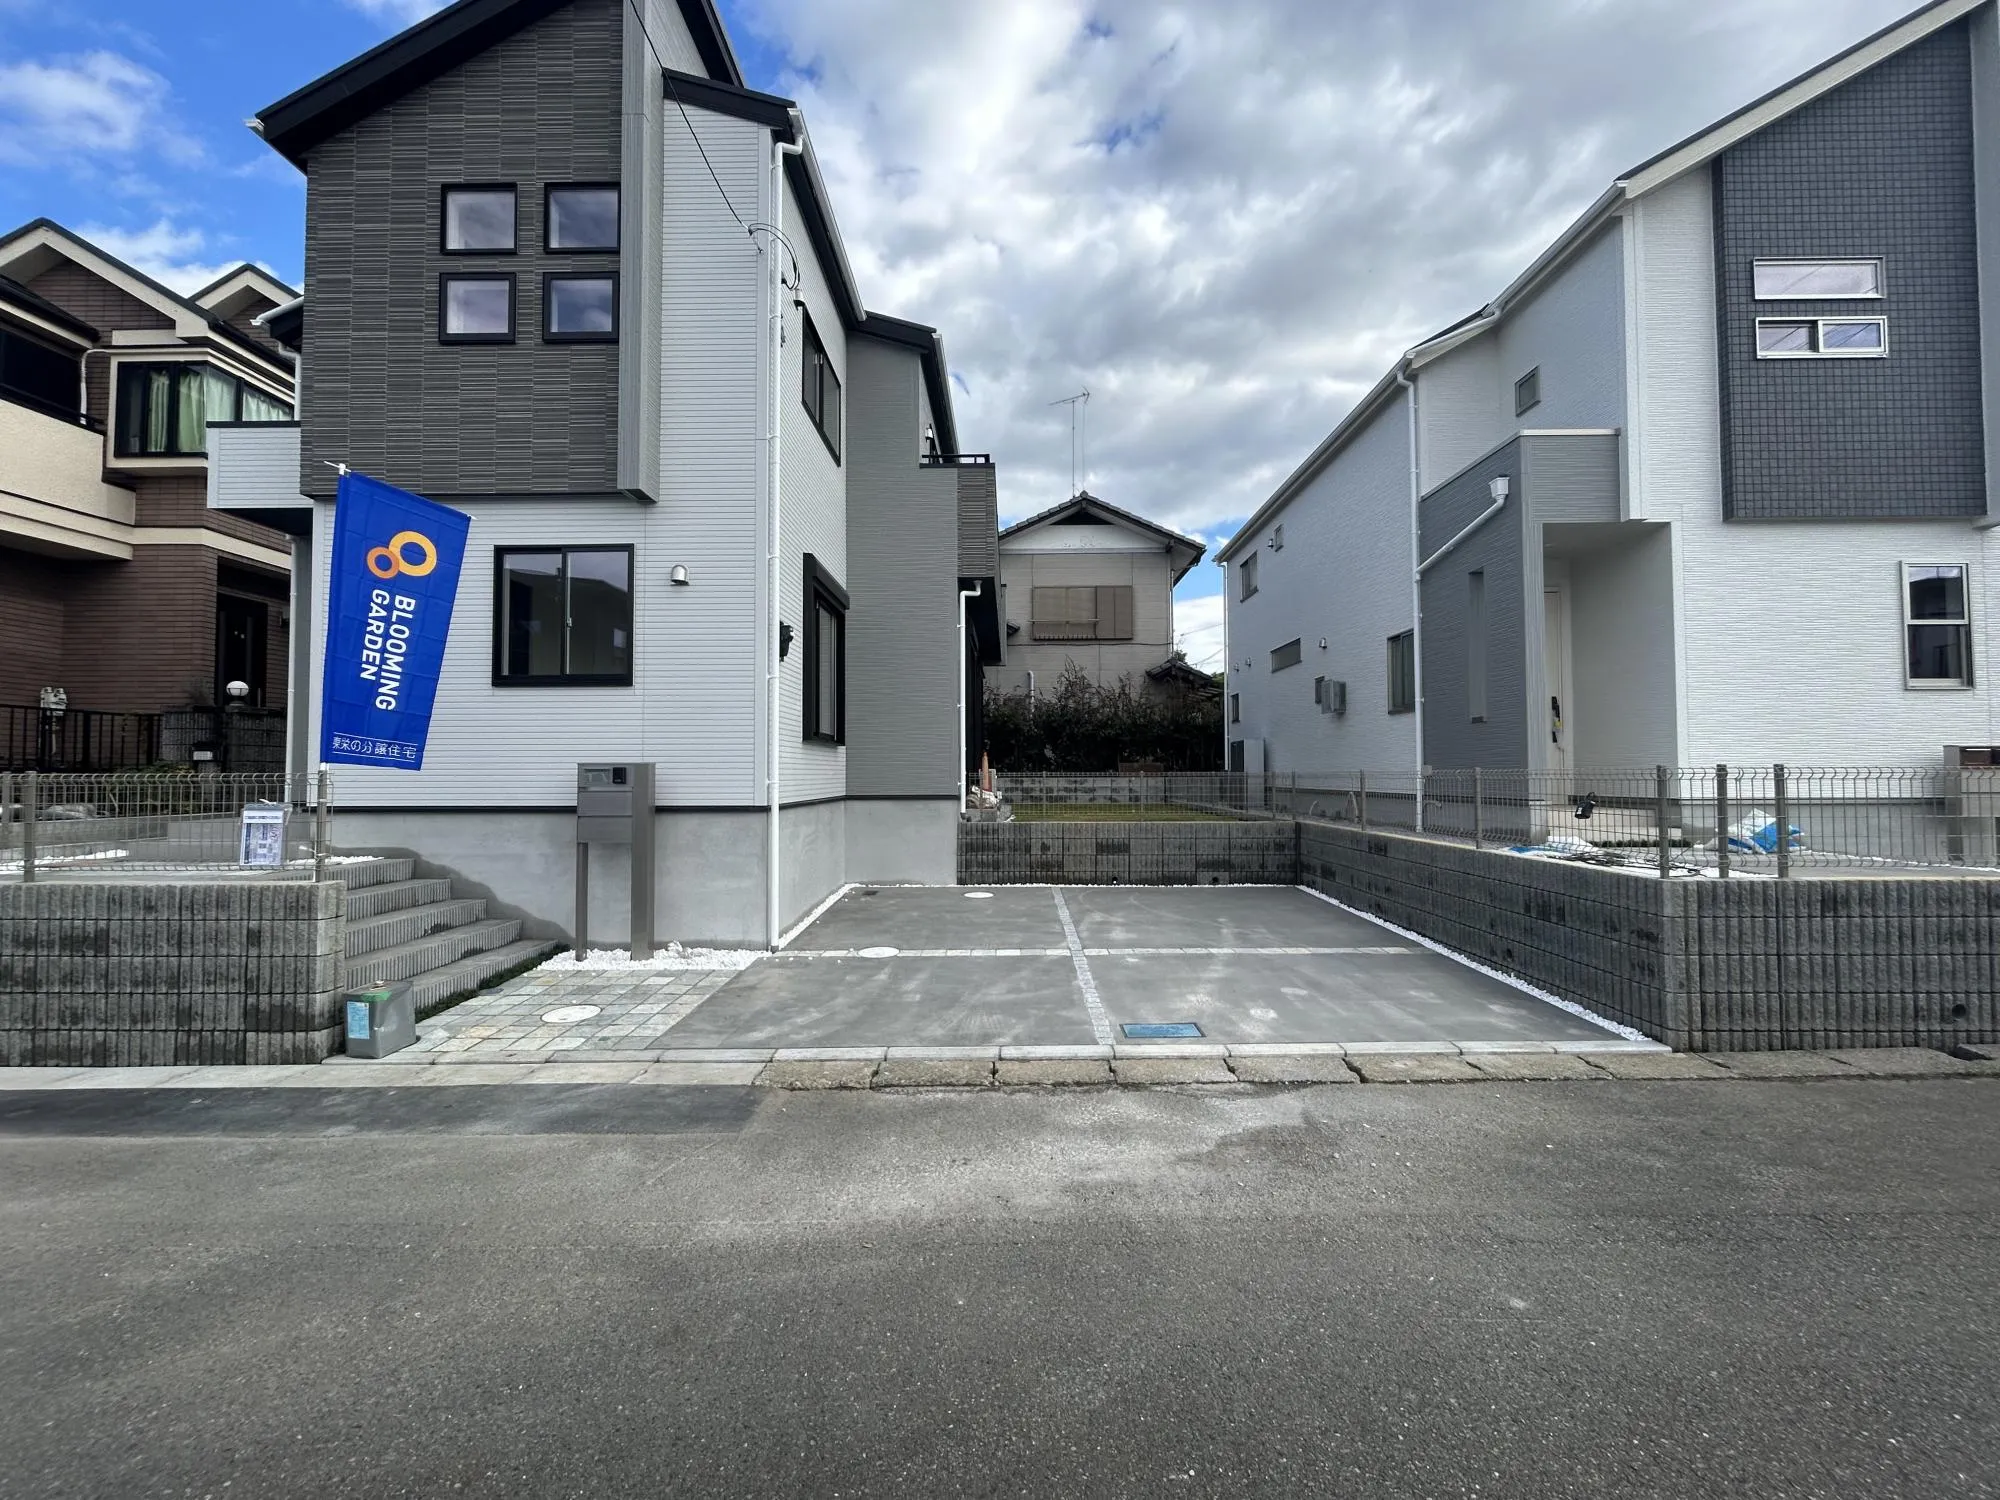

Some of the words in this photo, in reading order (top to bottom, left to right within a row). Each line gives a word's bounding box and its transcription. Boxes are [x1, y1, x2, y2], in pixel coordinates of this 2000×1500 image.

[360, 588, 390, 681] GARDEN
[375, 594, 416, 711] BLOOMING
[332, 736, 417, 760] 東栄の分譲住宅
